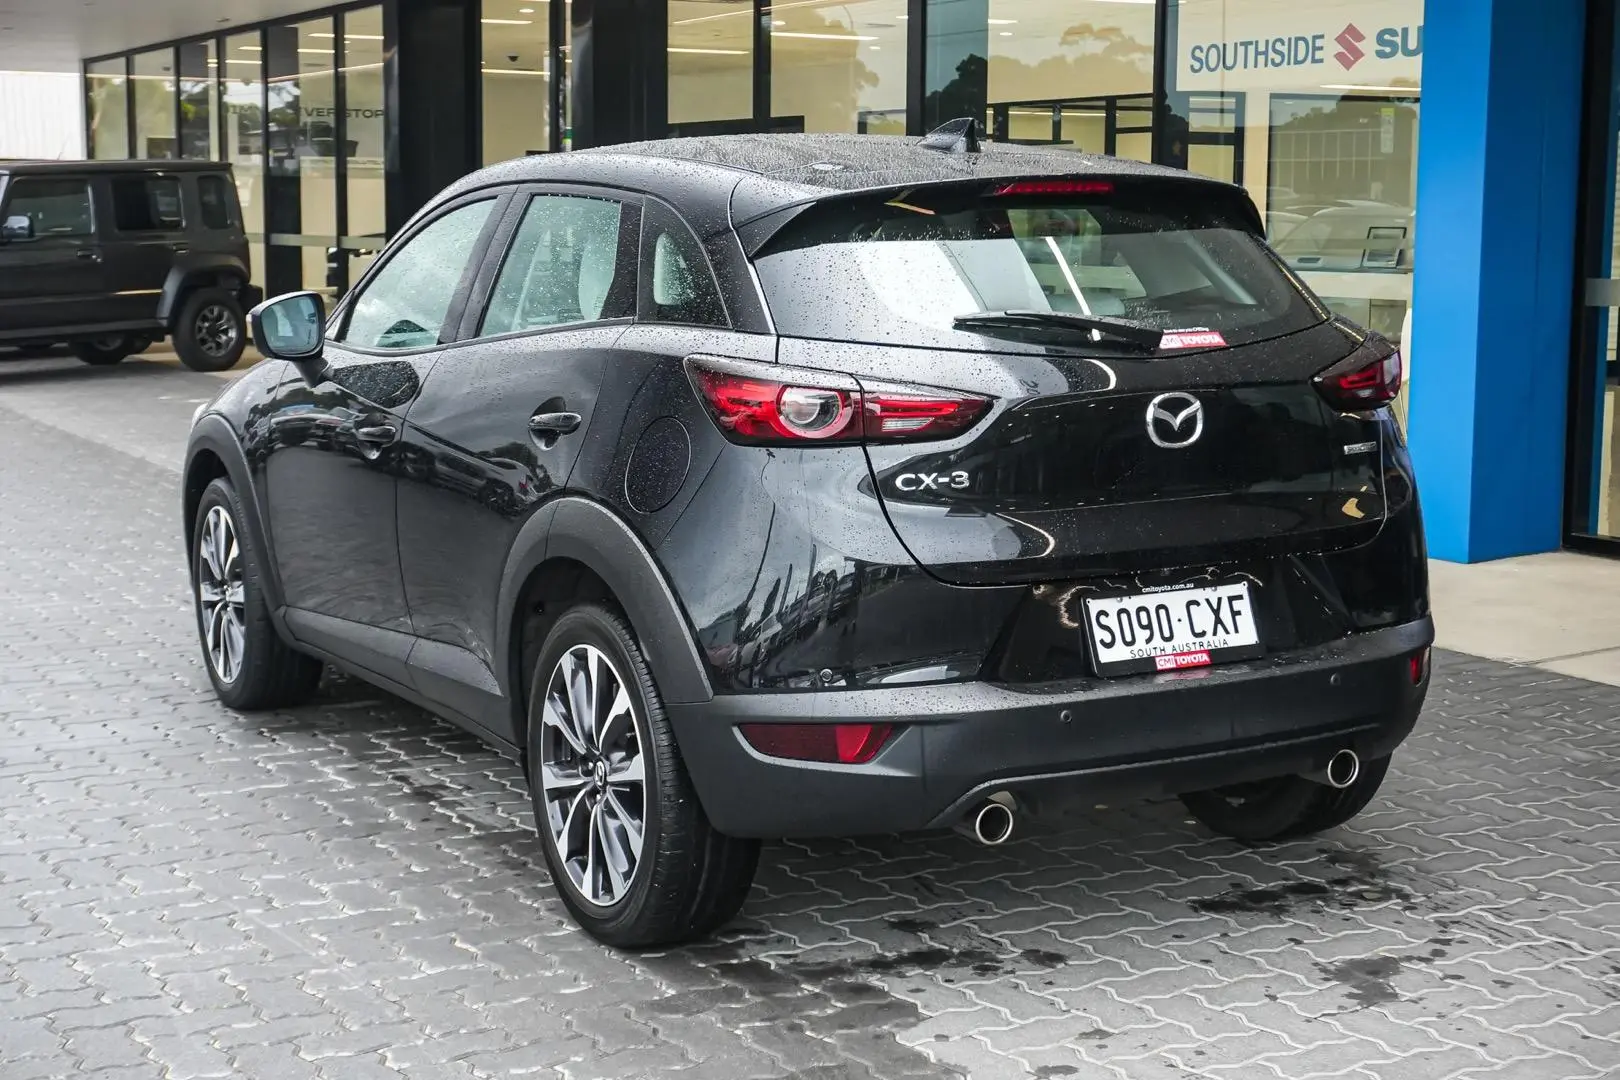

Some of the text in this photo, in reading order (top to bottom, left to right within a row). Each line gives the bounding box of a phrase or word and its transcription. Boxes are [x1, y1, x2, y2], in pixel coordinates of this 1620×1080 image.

[1190, 34, 1325, 74] SOUTHSIDE
[895, 470, 970, 491] CX-3
[1141, 582, 1194, 593] cmitoyota.com.au
[1130, 638, 1229, 658] SOUTH AUSTRALIA
[1157, 653, 1209, 668] CMI TOYOTA
